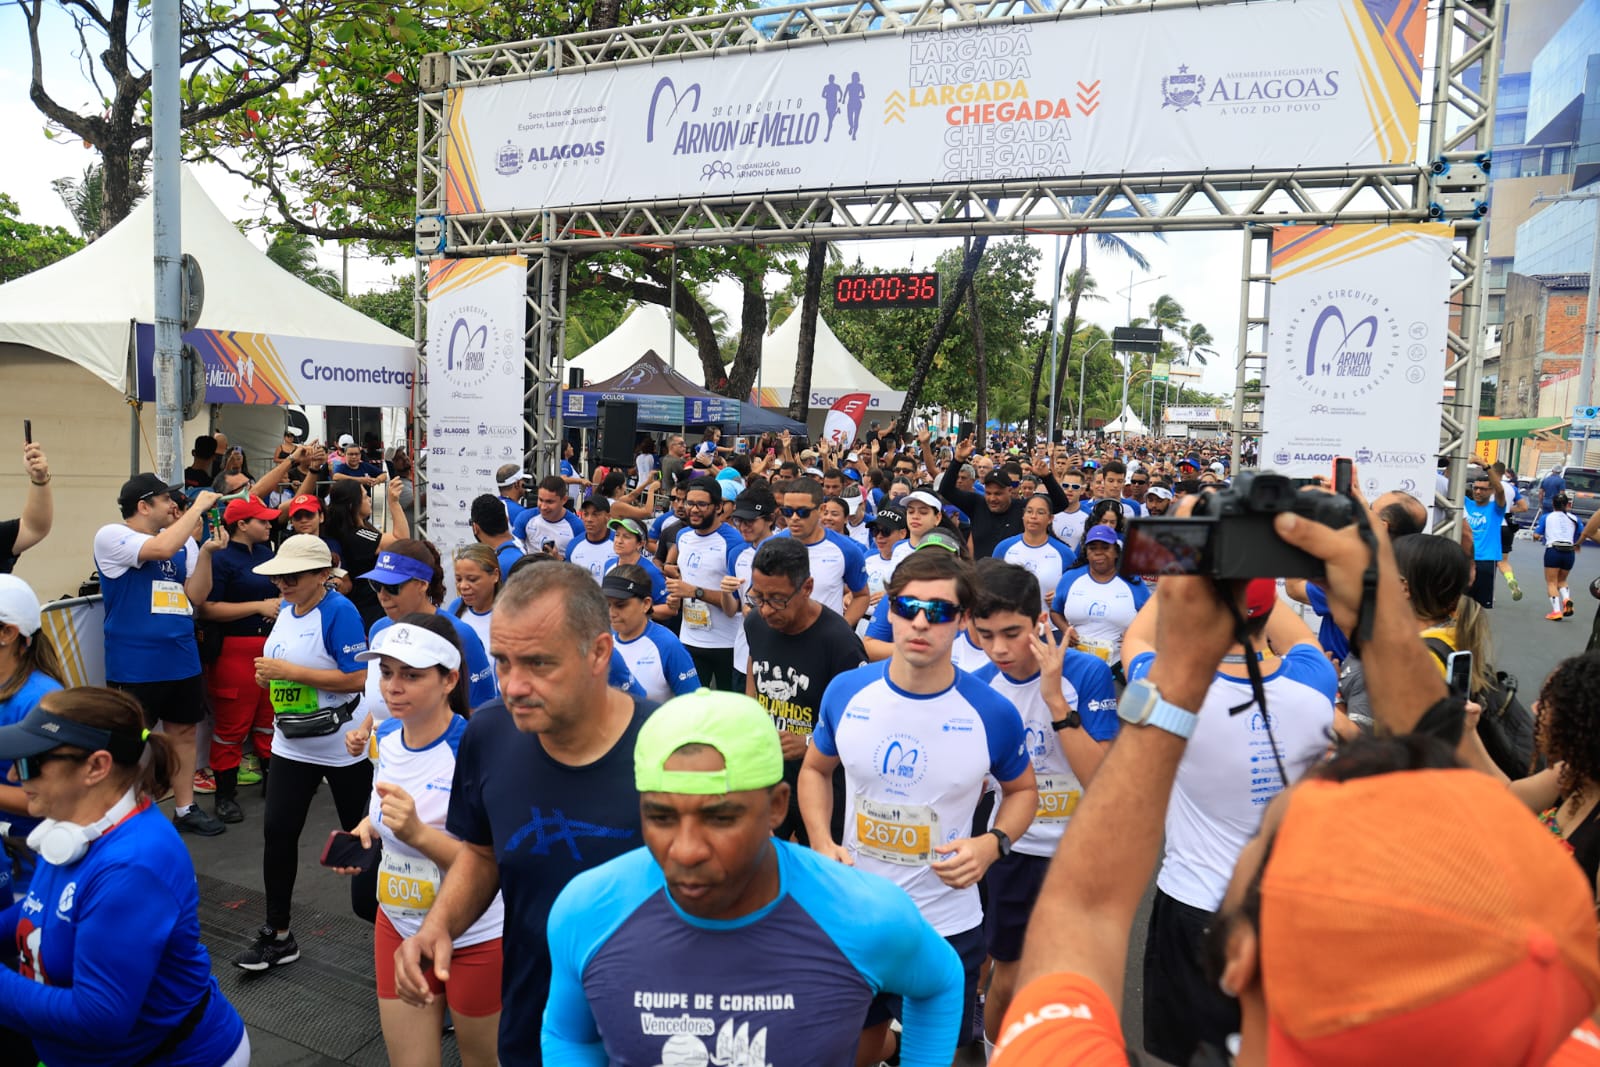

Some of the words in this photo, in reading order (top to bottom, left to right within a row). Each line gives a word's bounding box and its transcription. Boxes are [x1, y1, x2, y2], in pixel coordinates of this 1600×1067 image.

[910, 34, 1032, 65] LARGADA
[909, 57, 1031, 87] LARGADA
[909, 80, 1029, 107] LARGADA
[1207, 70, 1340, 102] ALAGOAS
[528, 111, 561, 120] Secretaria
[572, 106, 596, 115] Estado
[727, 98, 803, 116] CIRCUITO
[946, 98, 1071, 125] CHEGADA
[1220, 107, 1227, 116] A
[1232, 105, 1257, 115] VOZ
[1262, 104, 1281, 114] DO
[1286, 103, 1321, 112] POVO
[673, 120, 740, 155] ARNON
[740, 122, 759, 145] DE
[758, 111, 820, 148] MELLO
[944, 119, 1071, 147] CHEGADA
[528, 140, 605, 162] ALAGOAS
[944, 142, 1071, 169] CHEGADA
[532, 158, 600, 170] GOVERNO
[737, 169, 764, 178] ARNON
[776, 167, 801, 175] MELLO
[837, 275, 935, 302] 00:00:36
[1328, 289, 1379, 306] CIRCUITO
[1336, 351, 1373, 366] ARNON
[210, 370, 237, 387] MELLO
[1336, 365, 1346, 377] DE
[1346, 365, 1372, 377] MELLO
[168, 592, 179, 606] 14
[273, 687, 301, 702] 2787
[865, 820, 917, 847] 2670
[388, 876, 422, 902] 604
[634, 991, 688, 1011] EQUIPE
[694, 994, 713, 1010] DE
[719, 994, 795, 1011] CORRIDA
[641, 1013, 715, 1036] Vencedores
